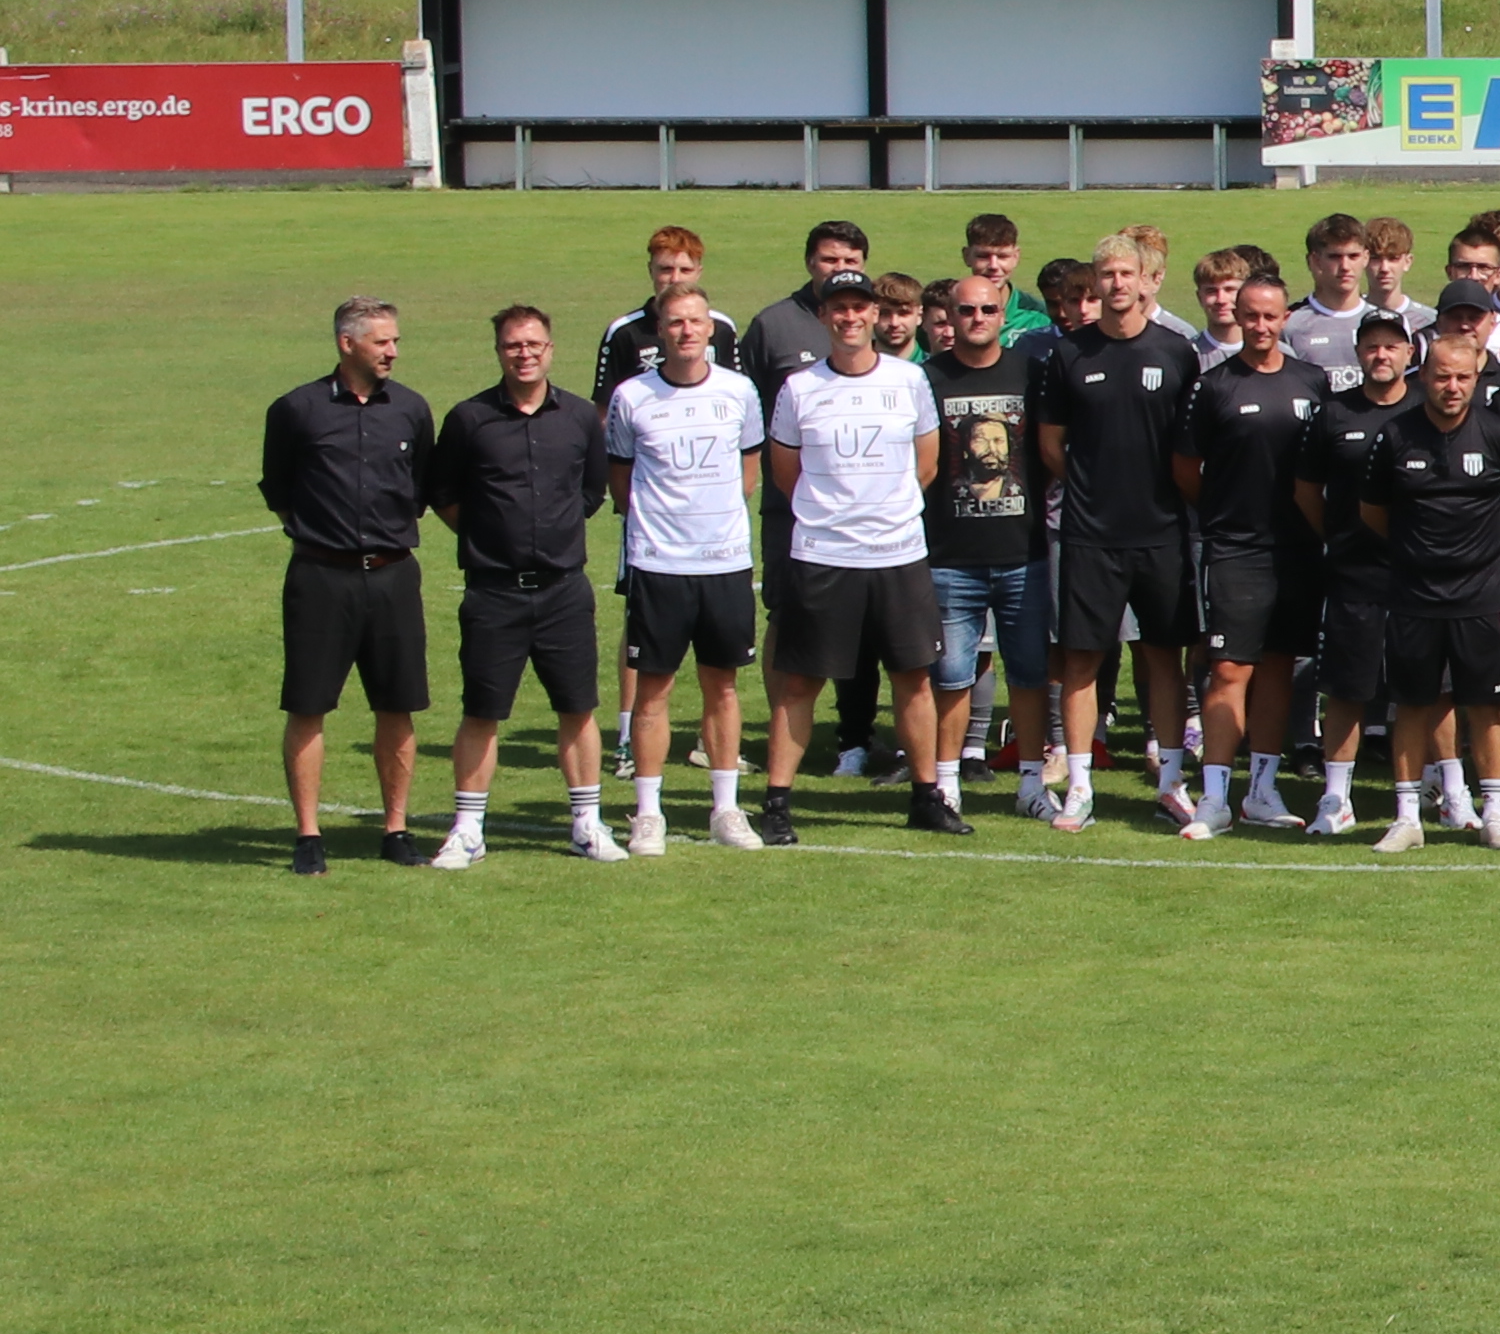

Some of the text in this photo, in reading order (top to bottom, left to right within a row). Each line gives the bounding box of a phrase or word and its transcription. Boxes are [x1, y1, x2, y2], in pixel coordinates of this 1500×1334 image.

[0, 95, 191, 120] s-krines.ergo.de
[242, 96, 371, 136] ERGO
[1408, 136, 1456, 144] EDEKA
[852, 396, 862, 405] 23
[685, 407, 695, 416] 27
[944, 399, 1024, 416] BUD SPENCER
